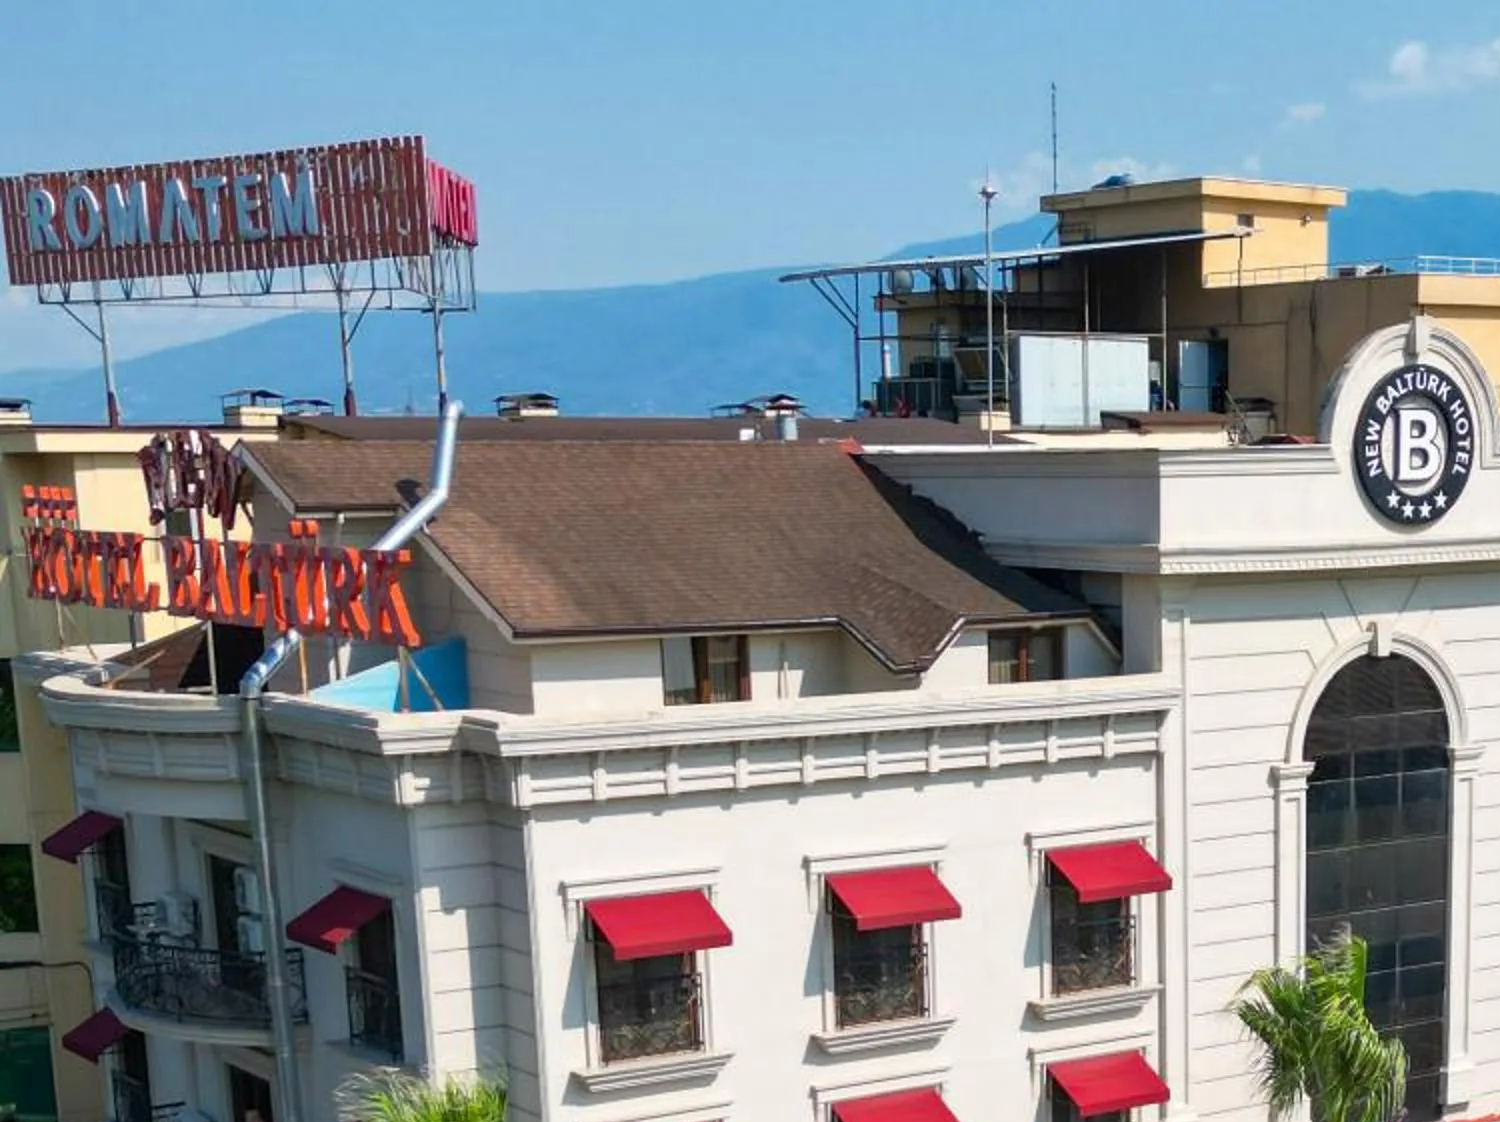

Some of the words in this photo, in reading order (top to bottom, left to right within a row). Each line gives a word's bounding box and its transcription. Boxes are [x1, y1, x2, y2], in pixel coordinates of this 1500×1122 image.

[27, 168, 322, 252] ROMATEM
[1365, 419, 1383, 478] NEW
[1376, 368, 1452, 415] BALTÜRK
[1450, 400, 1470, 476] HOTEL
[1396, 407, 1443, 482] B
